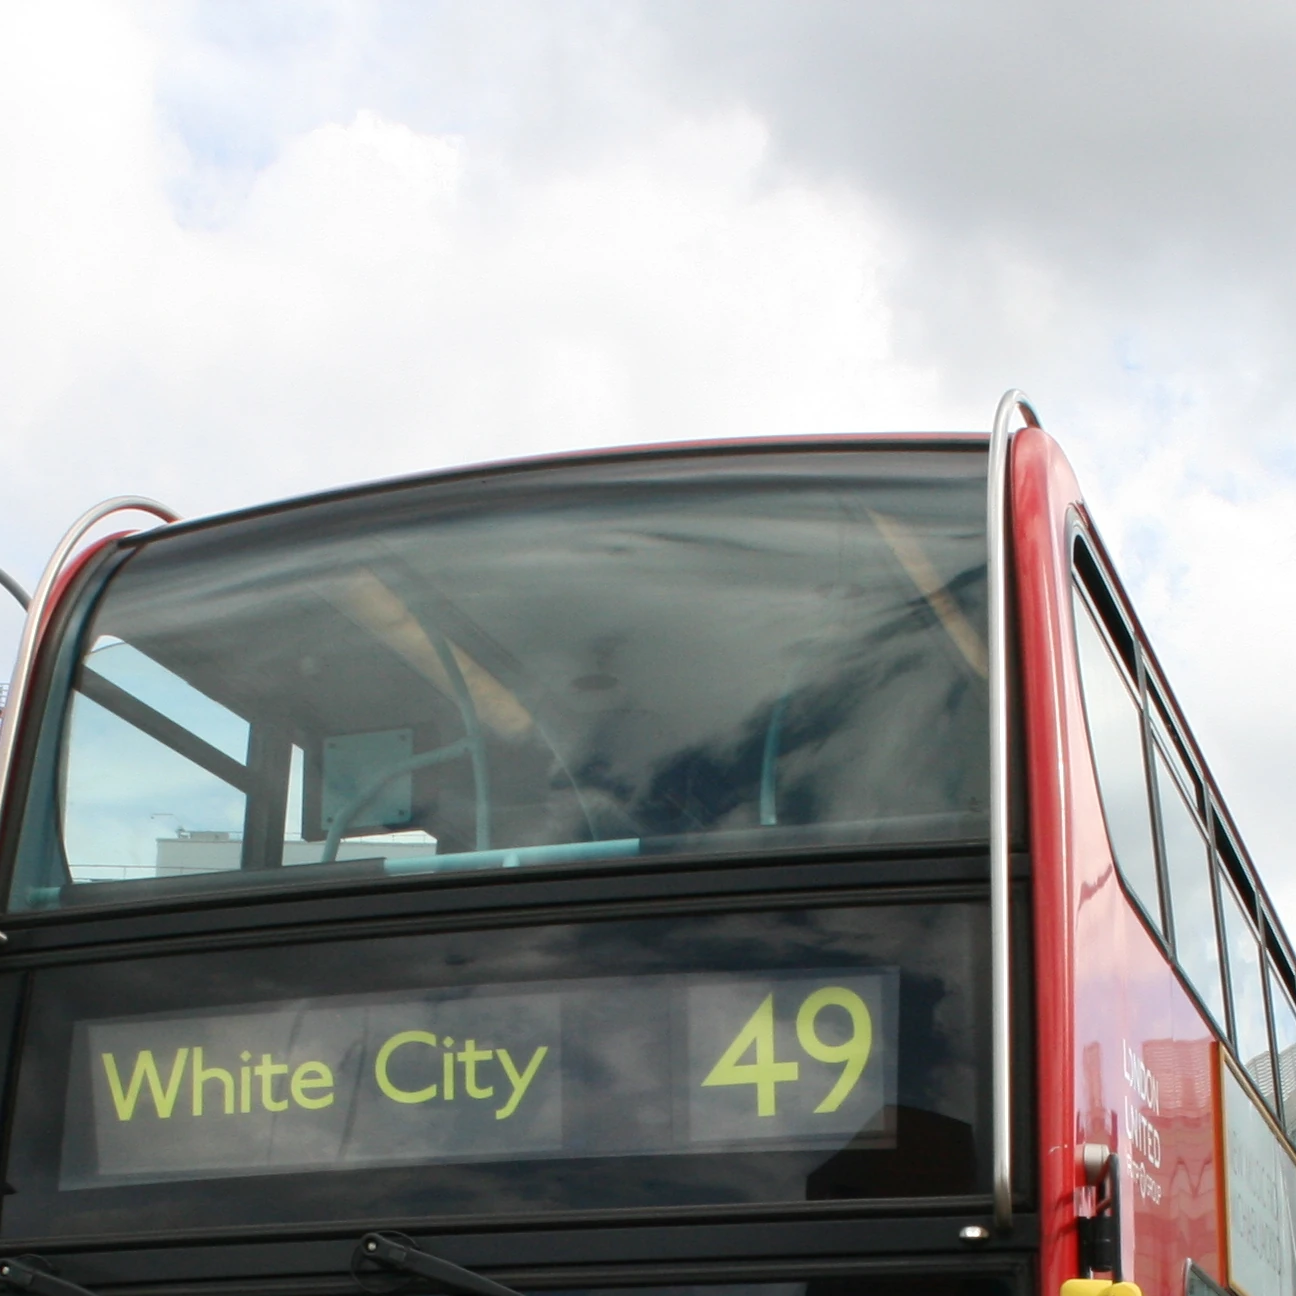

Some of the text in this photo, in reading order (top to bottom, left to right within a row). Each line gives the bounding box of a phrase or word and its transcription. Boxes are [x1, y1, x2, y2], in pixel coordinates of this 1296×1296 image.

[101, 1030, 548, 1121] White City
[701, 986, 872, 1117] 49
[1125, 1096, 1160, 1169] UNITED
